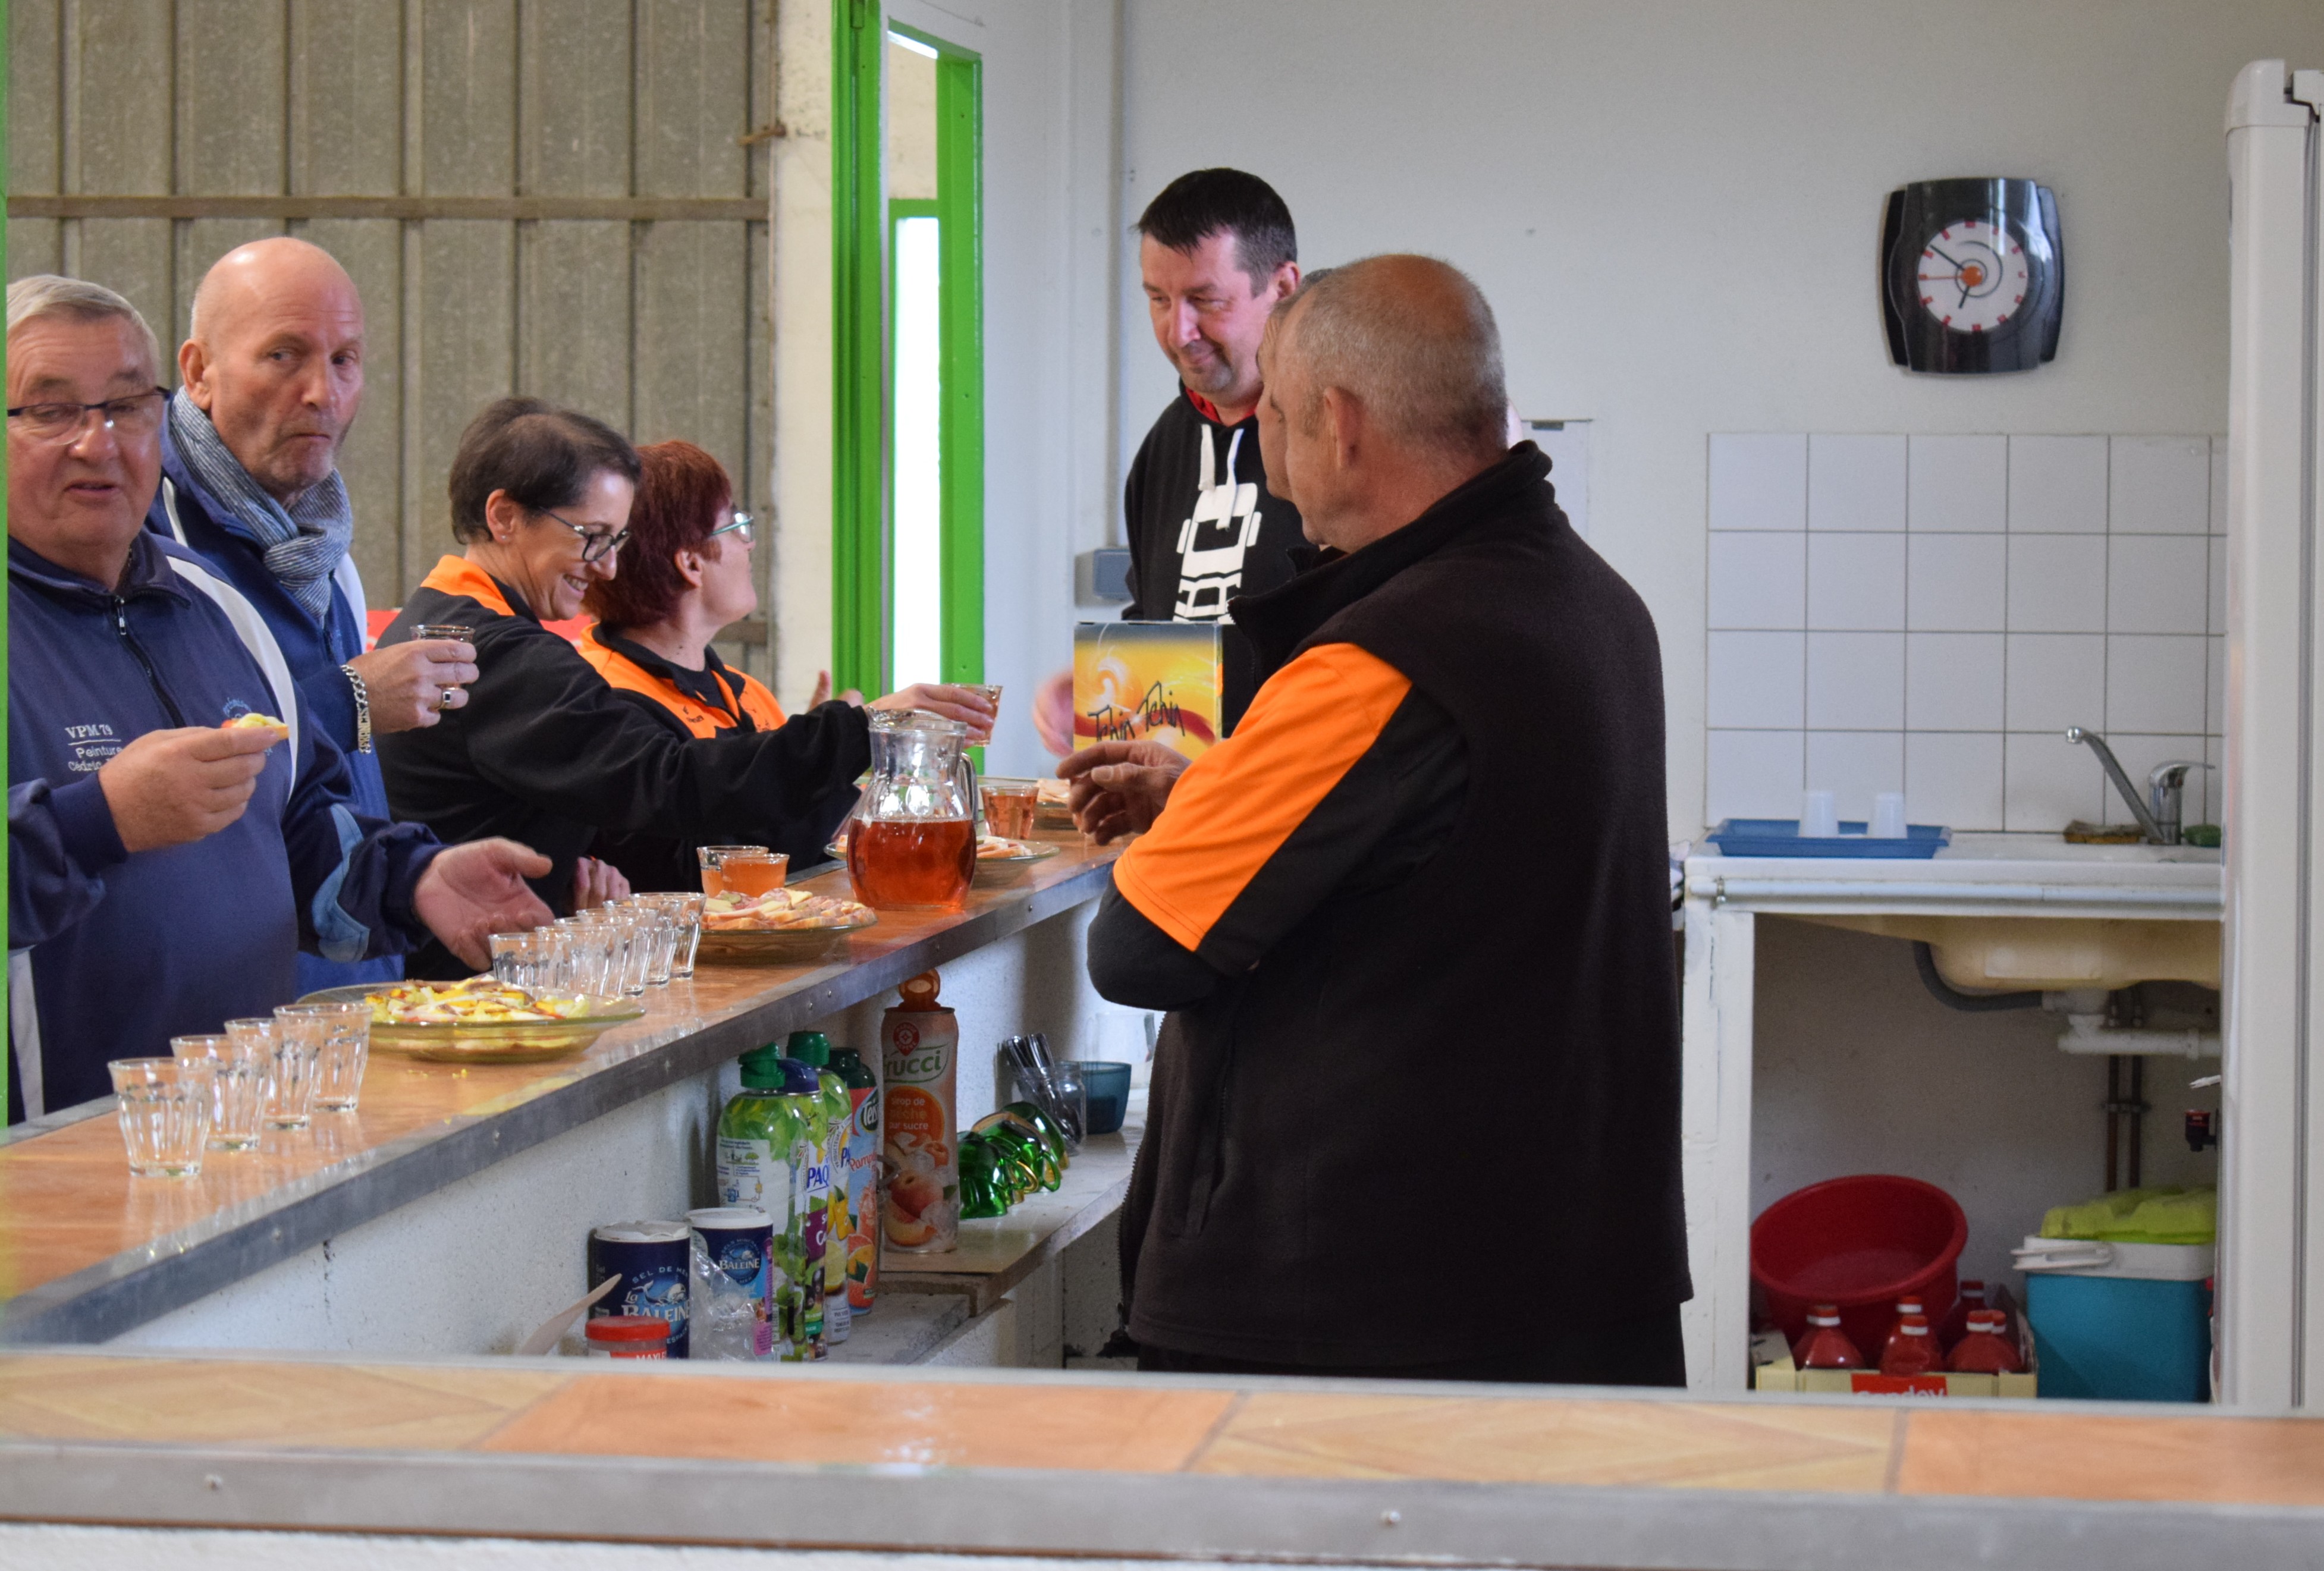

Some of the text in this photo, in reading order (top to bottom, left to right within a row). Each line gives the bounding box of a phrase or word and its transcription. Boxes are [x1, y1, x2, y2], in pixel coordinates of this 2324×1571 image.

[64, 724, 114, 738] VPM 79
[891, 1096, 926, 1107] sirop de
[903, 1121, 929, 1130] sucre
[719, 1258, 761, 1270] BALEINE
[632, 1270, 654, 1284] SEL
[625, 1291, 638, 1304] La
